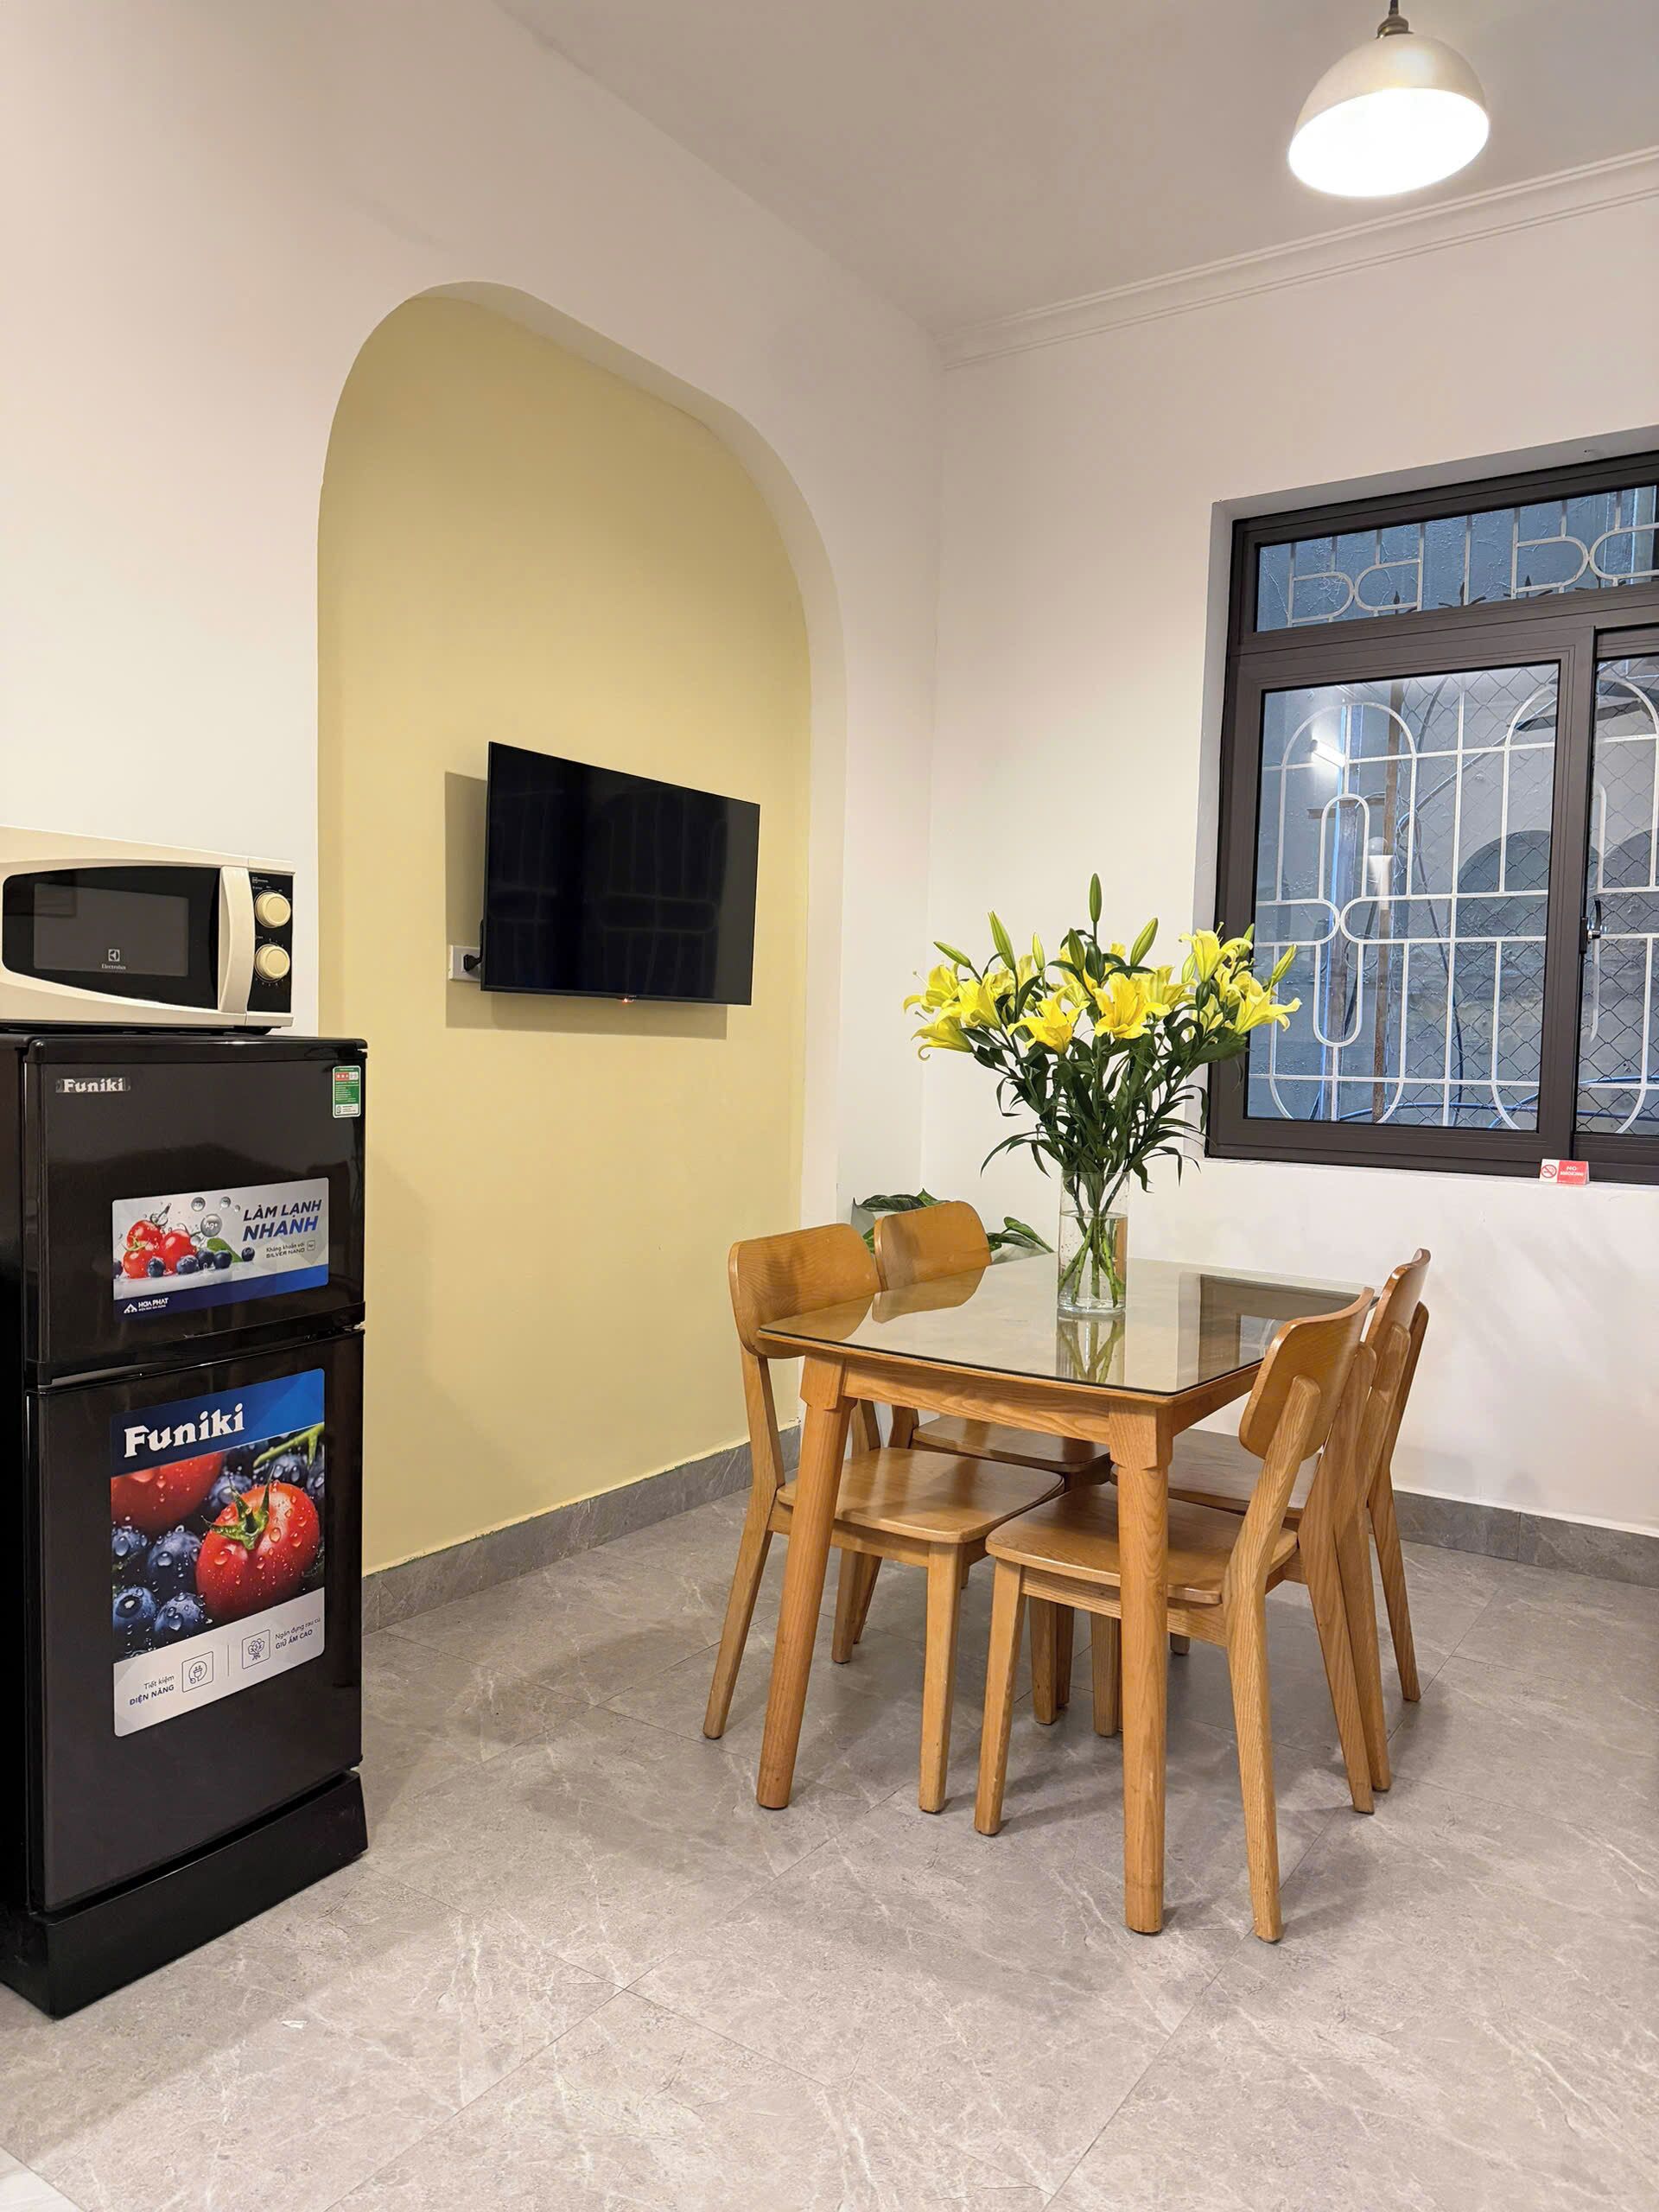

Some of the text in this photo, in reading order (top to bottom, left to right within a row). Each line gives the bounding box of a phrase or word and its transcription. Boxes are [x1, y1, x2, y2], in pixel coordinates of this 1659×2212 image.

[63, 1078, 124, 1093] Funiki
[244, 1199, 321, 1221] LÀM LẠNH
[243, 1216, 318, 1242] NHANH
[124, 1402, 245, 1459] Funiki
[299, 1629, 313, 1639] CAO
